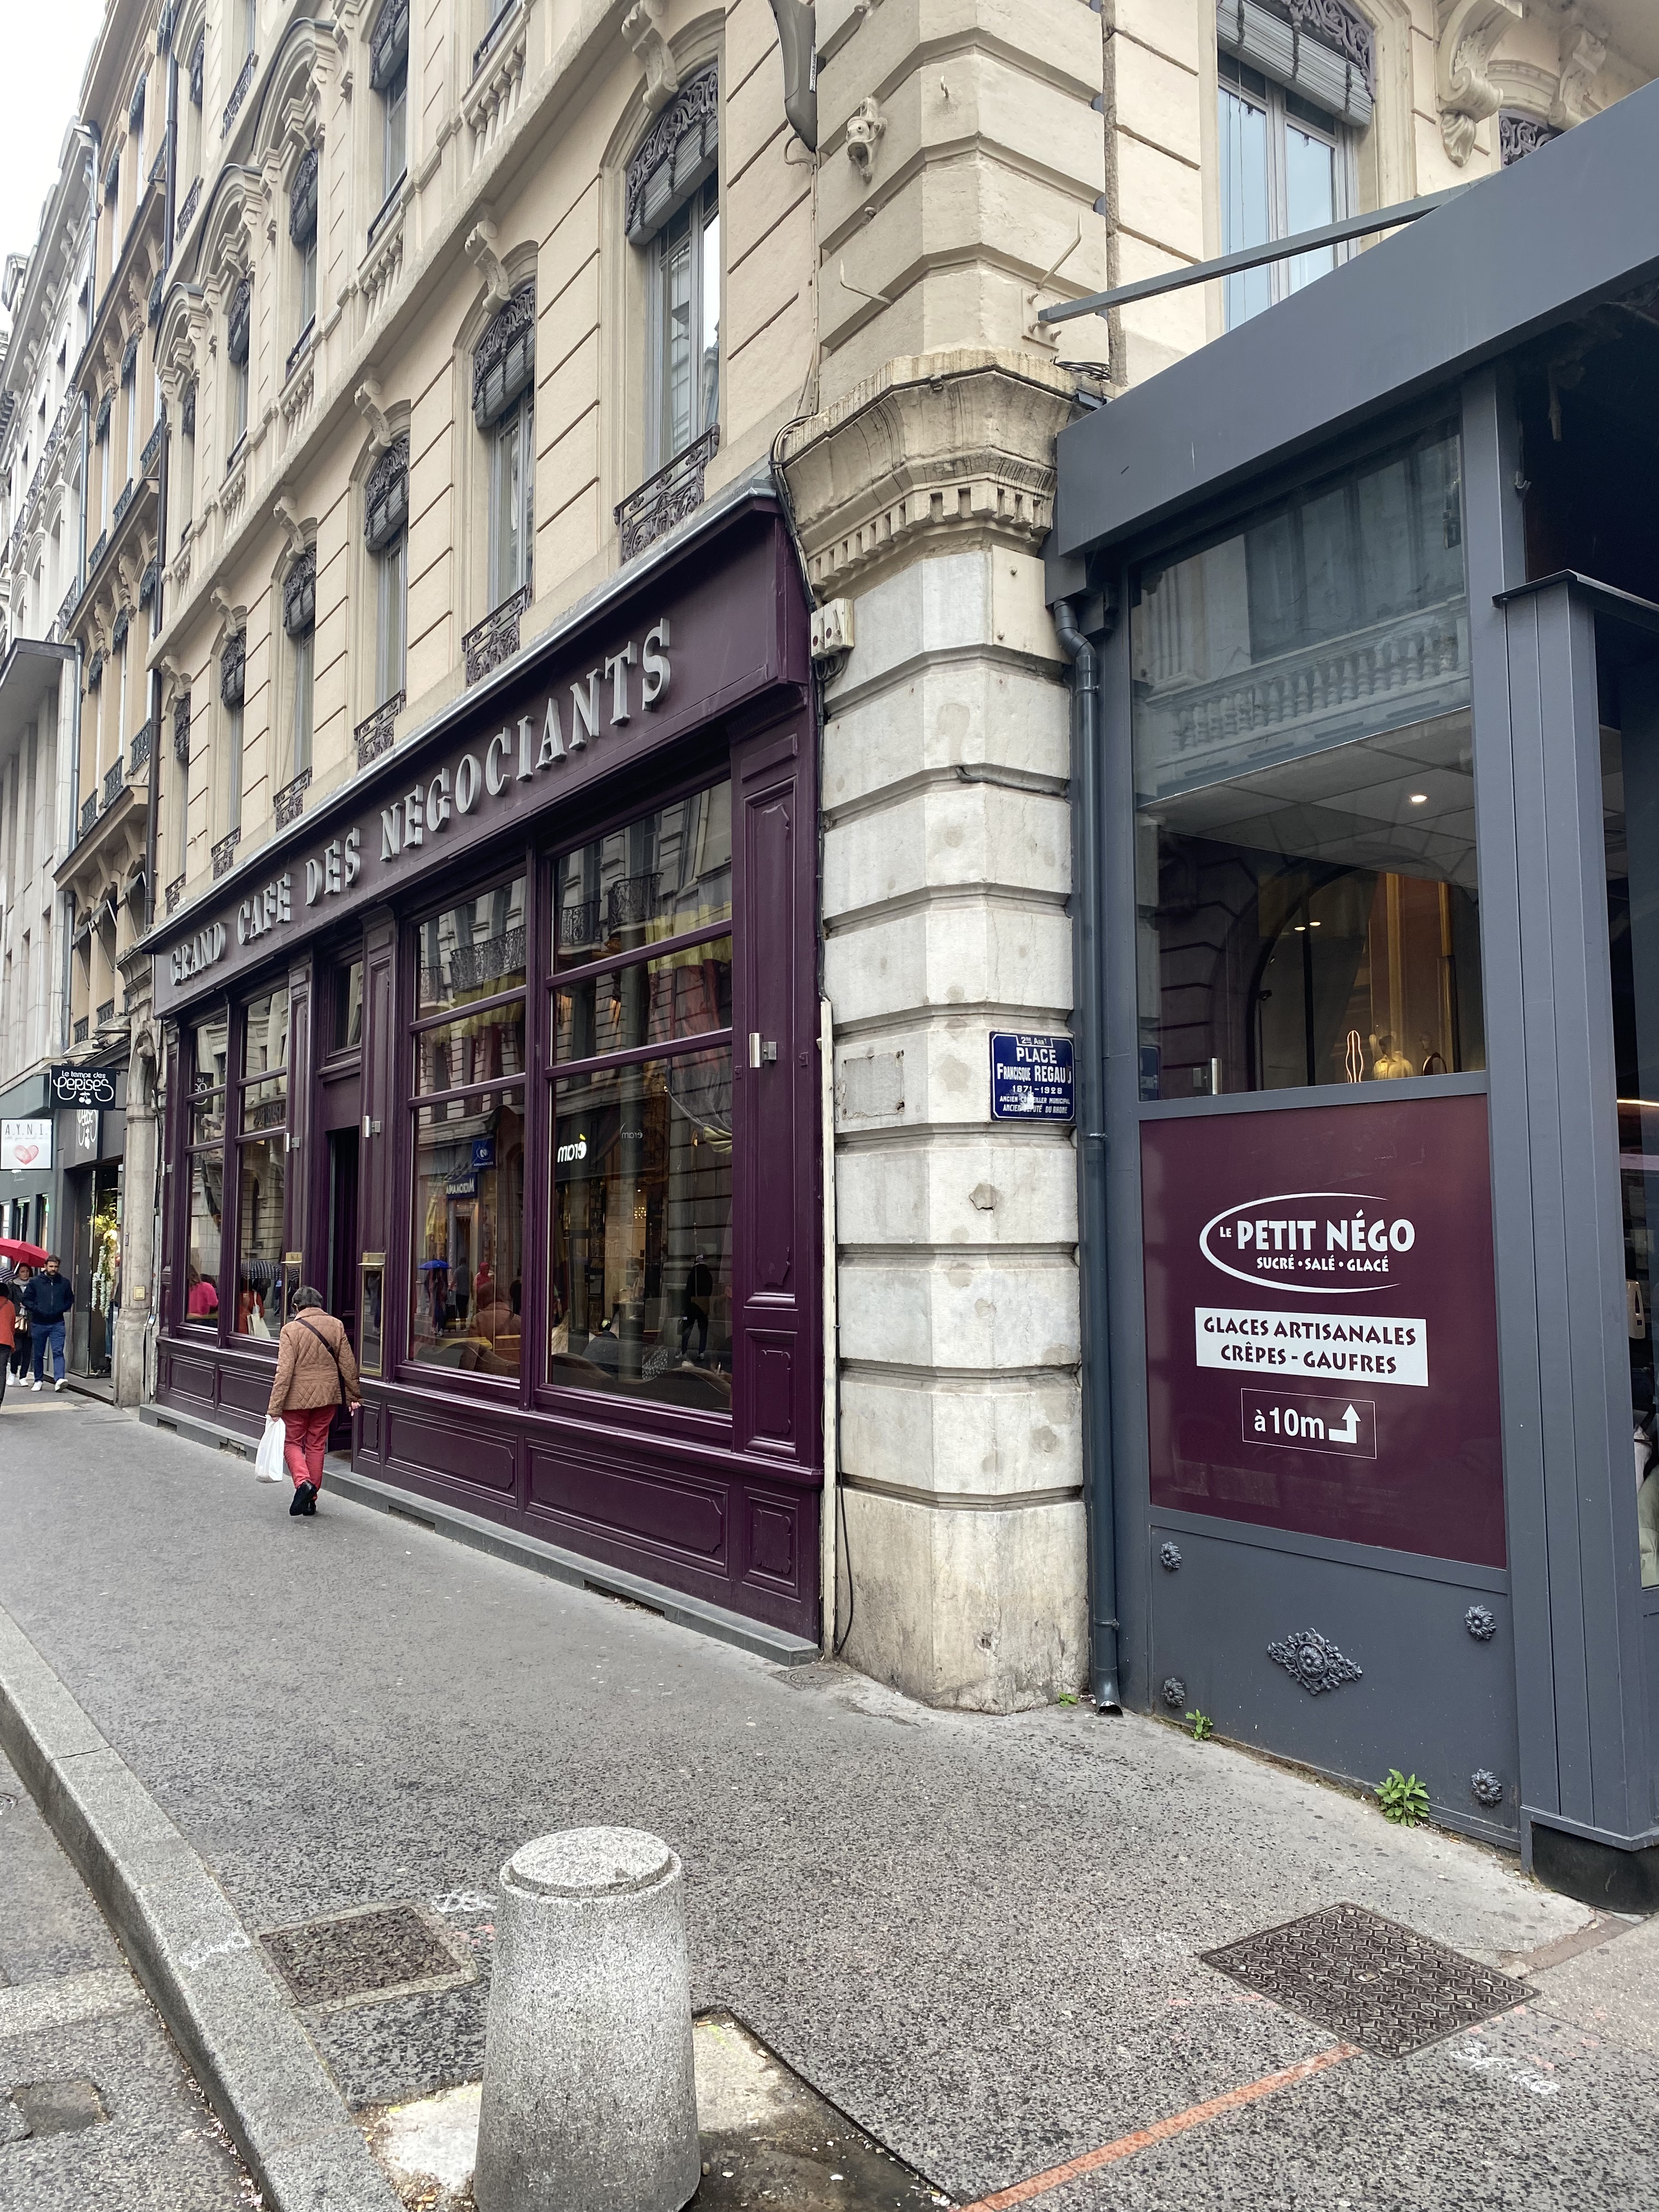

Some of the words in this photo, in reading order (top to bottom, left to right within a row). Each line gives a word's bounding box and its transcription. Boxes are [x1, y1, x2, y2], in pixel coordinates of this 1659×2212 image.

[170, 922, 226, 986] GRAND
[238, 873, 291, 945] CAFE
[305, 828, 360, 906] DES
[380, 618, 670, 861] NEGOCIANTS
[1016, 1047, 1057, 1064] PLACE
[997, 1063, 1031, 1082] FRANCISQUE
[1220, 1226, 1232, 1238] LE
[1237, 1220, 1317, 1250] PETIT
[1327, 1209, 1415, 1252] NÉGO
[1256, 1254, 1295, 1270] SUCRÉ
[1305, 1254, 1335, 1271] SALÉ
[1346, 1255, 1389, 1272] GLACÉ
[1204, 1317, 1269, 1336] GLACES
[1273, 1320, 1416, 1346] ARTISANALES
[1221, 1341, 1286, 1365] CRÊPES
[1303, 1350, 1397, 1374] GAUFRES
